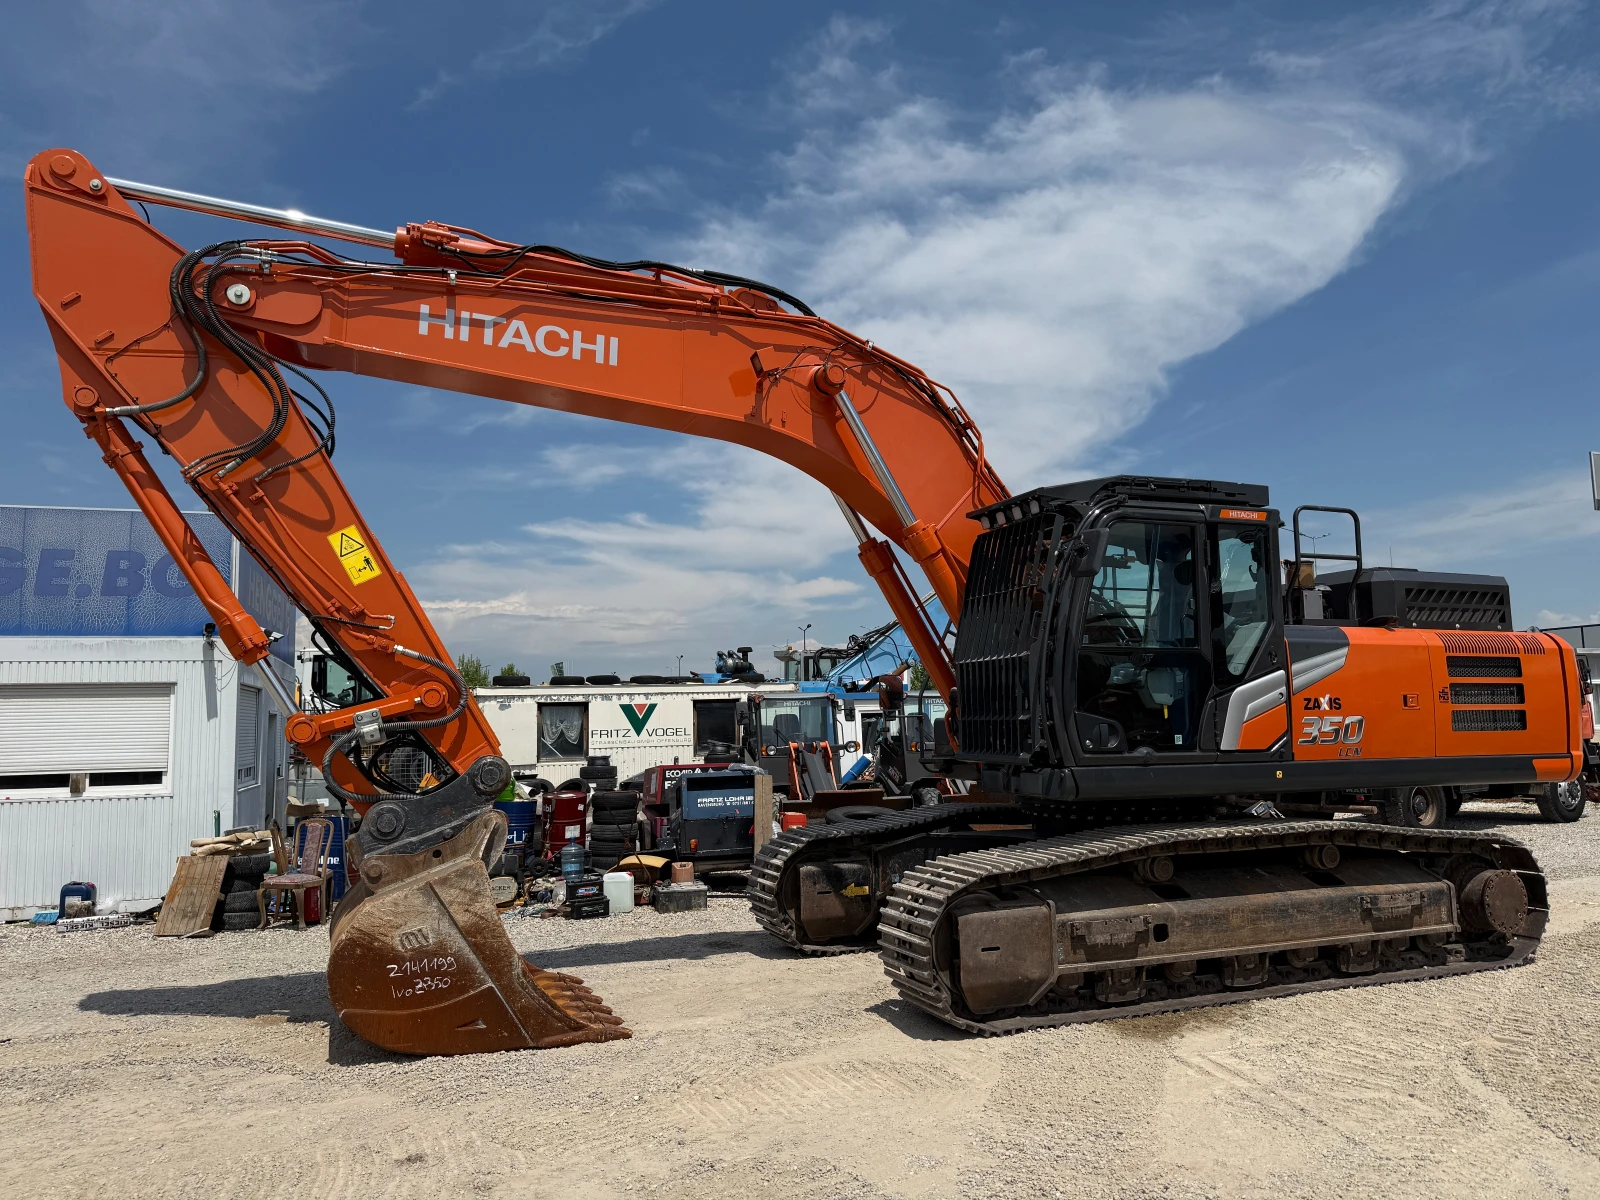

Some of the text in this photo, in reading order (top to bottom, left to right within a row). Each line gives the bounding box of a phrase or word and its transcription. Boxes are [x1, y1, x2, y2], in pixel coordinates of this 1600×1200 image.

[418, 303, 619, 367] HITACHI
[1229, 510, 1258, 519] HITACHI
[1303, 694, 1342, 711] ZAXIS
[591, 727, 692, 739] FRITZ VOGEL
[1297, 715, 1365, 745] 350
[1338, 746, 1363, 758] LCN
